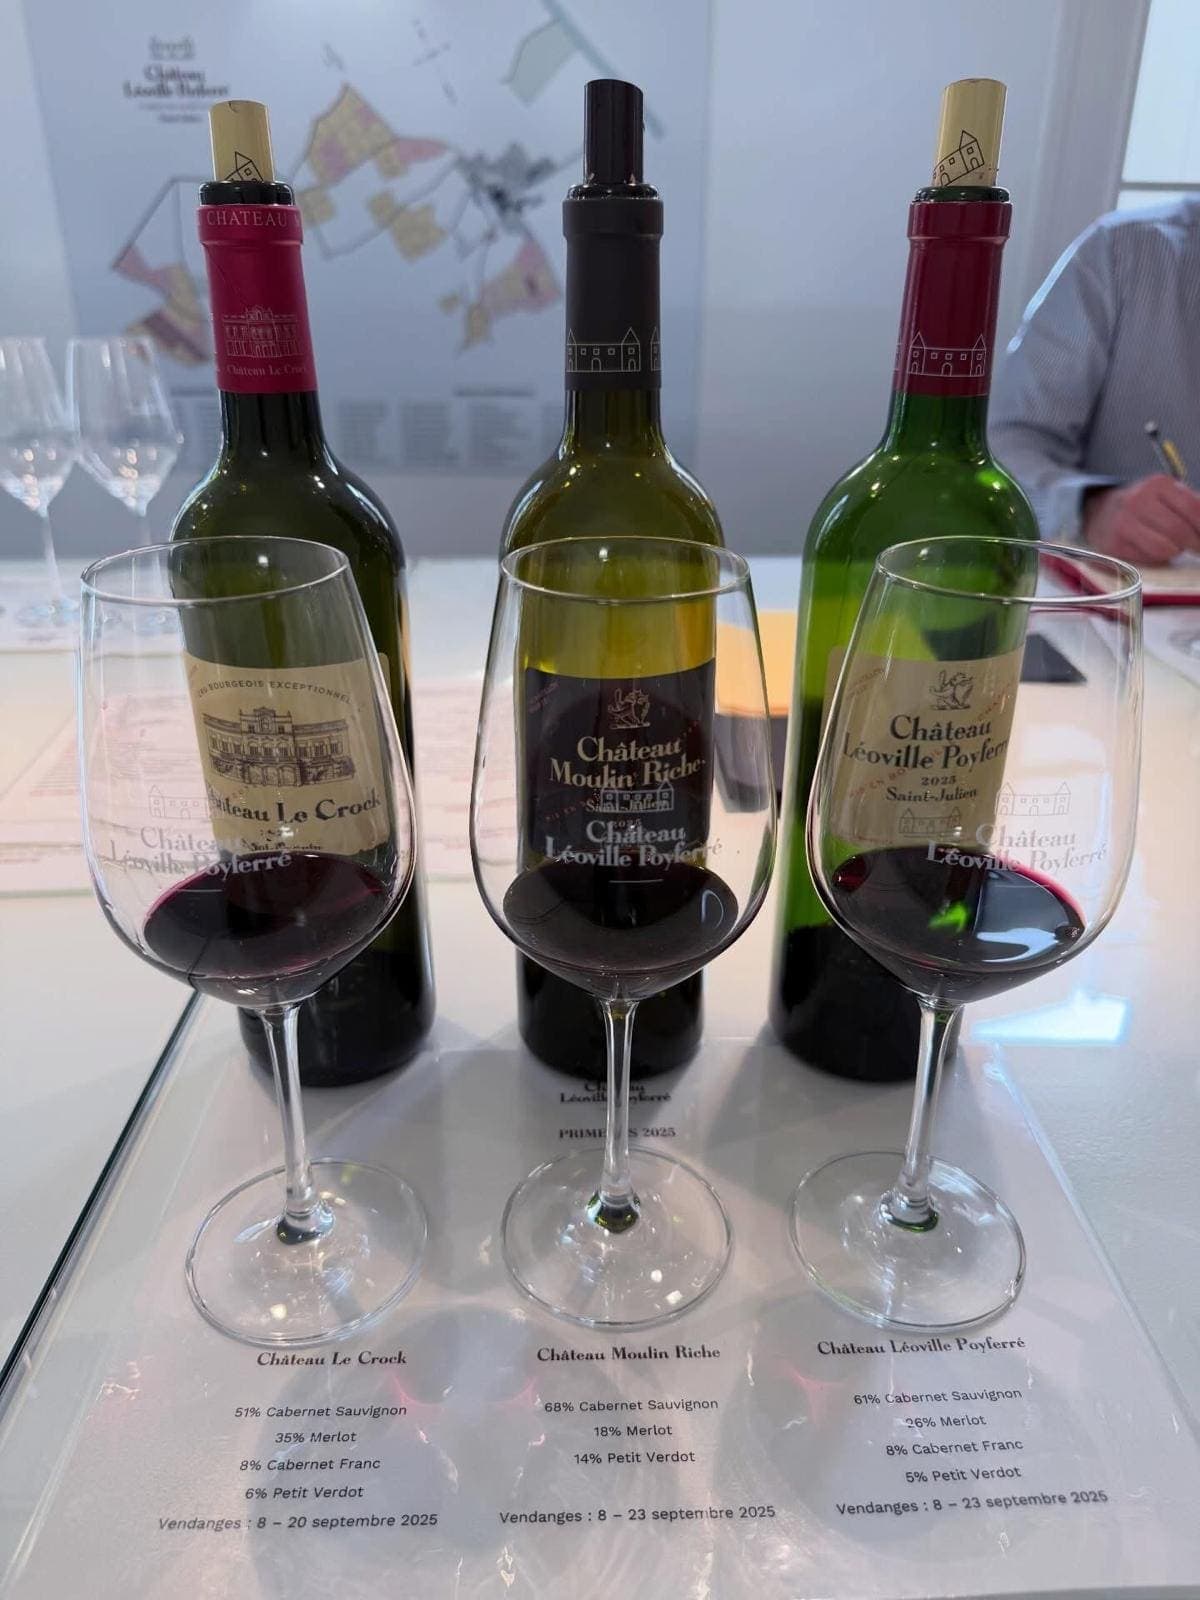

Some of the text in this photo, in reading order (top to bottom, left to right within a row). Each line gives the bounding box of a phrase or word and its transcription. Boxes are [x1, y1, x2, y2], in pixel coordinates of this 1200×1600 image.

[206, 210, 287, 227] CHATEAU
[269, 681, 353, 704] EXCEPTIONNEL
[890, 714, 992, 743] Château
[577, 736, 683, 763] Château
[843, 732, 934, 769] Léoville
[942, 737, 1009, 775] Poyferr
[550, 752, 701, 789] Moulin Riche
[920, 775, 957, 787] 2025
[886, 786, 977, 802] Saint-Julien
[276, 802, 308, 823] Le
[315, 787, 382, 821] Crock
[586, 820, 686, 845] Château
[975, 823, 1077, 847] Château
[545, 836, 632, 867] Léoville
[926, 839, 1107, 875] Léoville Poyferré
[560, 1127, 677, 1138] PRIMES 2025
[537, 1345, 721, 1362] Château Moulin Riche
[817, 1336, 1026, 1356] Château Léoville Poyferré
[257, 1350, 408, 1367] Château Le Crock
[854, 1388, 1023, 1405] 61% Cabernet Sauvignon
[234, 1405, 408, 1419] 51% Cabernet Sauvignon
[544, 1399, 719, 1413] 68% Cabernet Sauvignon
[905, 1415, 987, 1429] 26% Merlot
[275, 1431, 357, 1444] 35% Merlot
[594, 1425, 673, 1437] 18% Merlot
[886, 1440, 1024, 1457] 8% Cabernet Franc
[240, 1458, 381, 1472] 8% Cabernet Franc
[574, 1450, 696, 1465] 14% Petit Verdot
[905, 1466, 1022, 1484] 5% Petit Verdot
[245, 1486, 364, 1500] 6% Petit Verdot
[836, 1501, 919, 1517] Vendanges
[933, 1499, 942, 1512] 8
[962, 1496, 981, 1510] 23
[986, 1492, 1067, 1510] septembre
[1070, 1489, 1108, 1504] 2025
[158, 1517, 241, 1532] Vendanges
[256, 1517, 267, 1530] 8
[287, 1516, 307, 1529] 20
[312, 1515, 396, 1530] septembre
[400, 1514, 438, 1527] 2025
[500, 1510, 583, 1526] Vendanges
[597, 1509, 607, 1522] 8
[628, 1508, 646, 1521] 23
[651, 1506, 734, 1523] septembre
[739, 1505, 776, 1519] 2025
